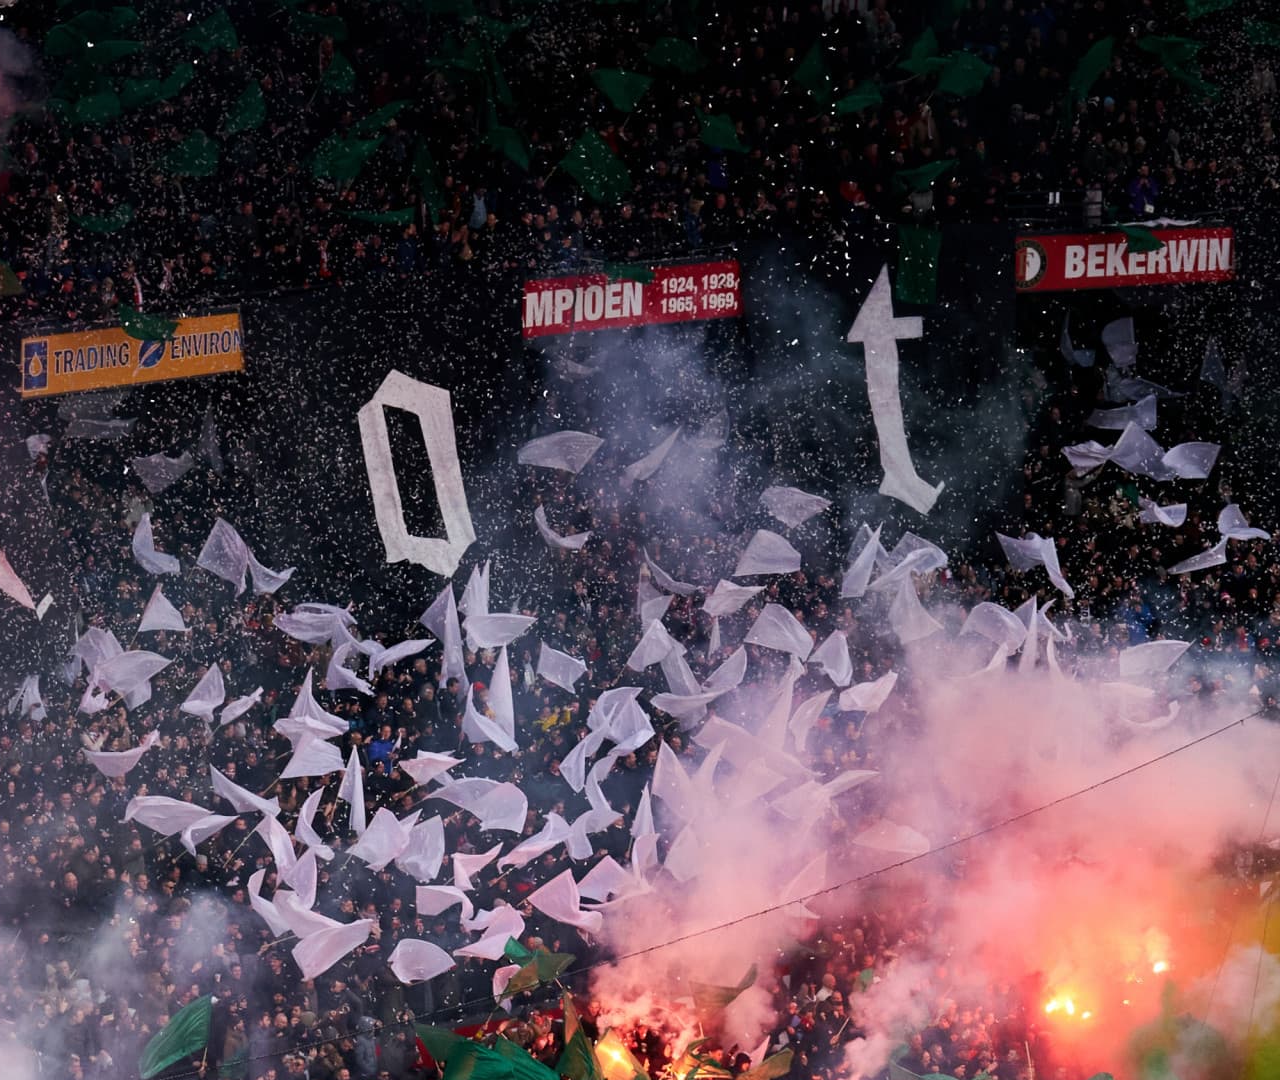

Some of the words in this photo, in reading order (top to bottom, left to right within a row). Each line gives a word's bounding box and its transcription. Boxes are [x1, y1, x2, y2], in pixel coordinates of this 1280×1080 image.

[1064, 236, 1232, 279] BEKERWIN
[660, 276, 698, 295] 1924,
[660, 296, 698, 315] 1965,
[701, 292, 739, 312] 1969,
[54, 342, 130, 376] TRADING
